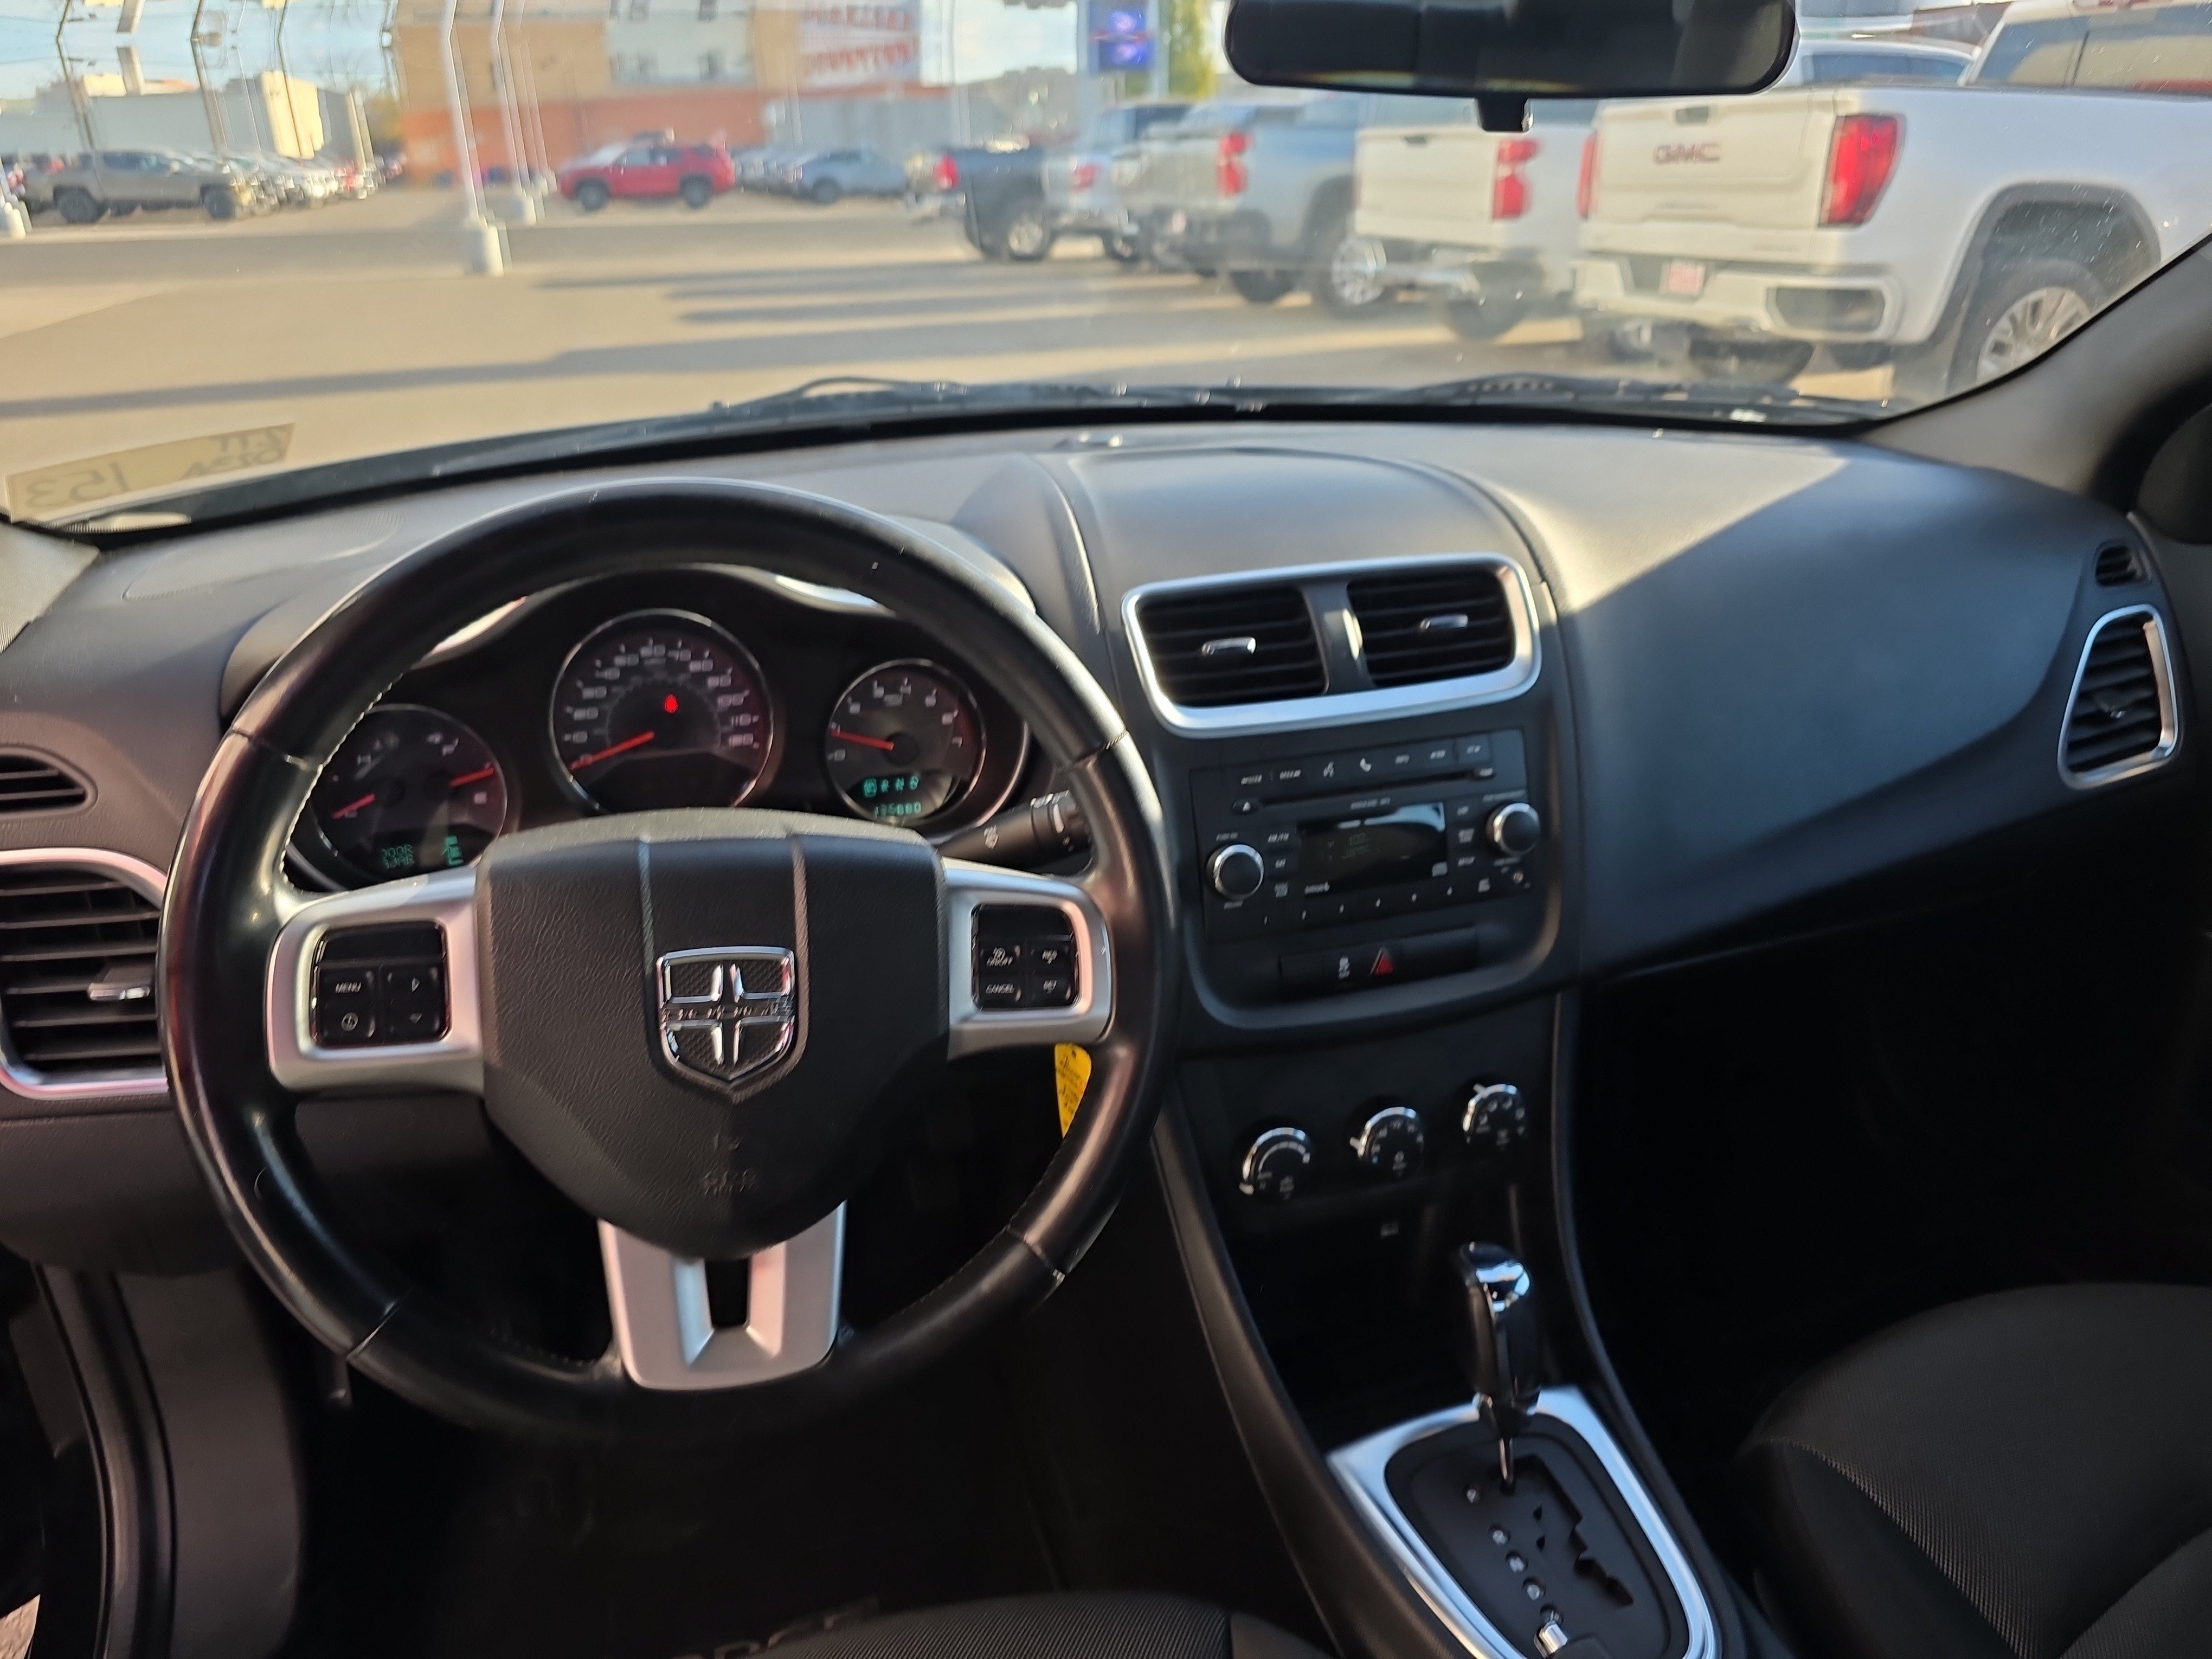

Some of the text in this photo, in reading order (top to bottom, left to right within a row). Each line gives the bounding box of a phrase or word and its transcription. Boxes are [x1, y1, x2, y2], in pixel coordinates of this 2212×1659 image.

[1655, 143, 1720, 163] GMC
[335, 981, 362, 994] MENU
[986, 983, 1015, 995] CANCEL
